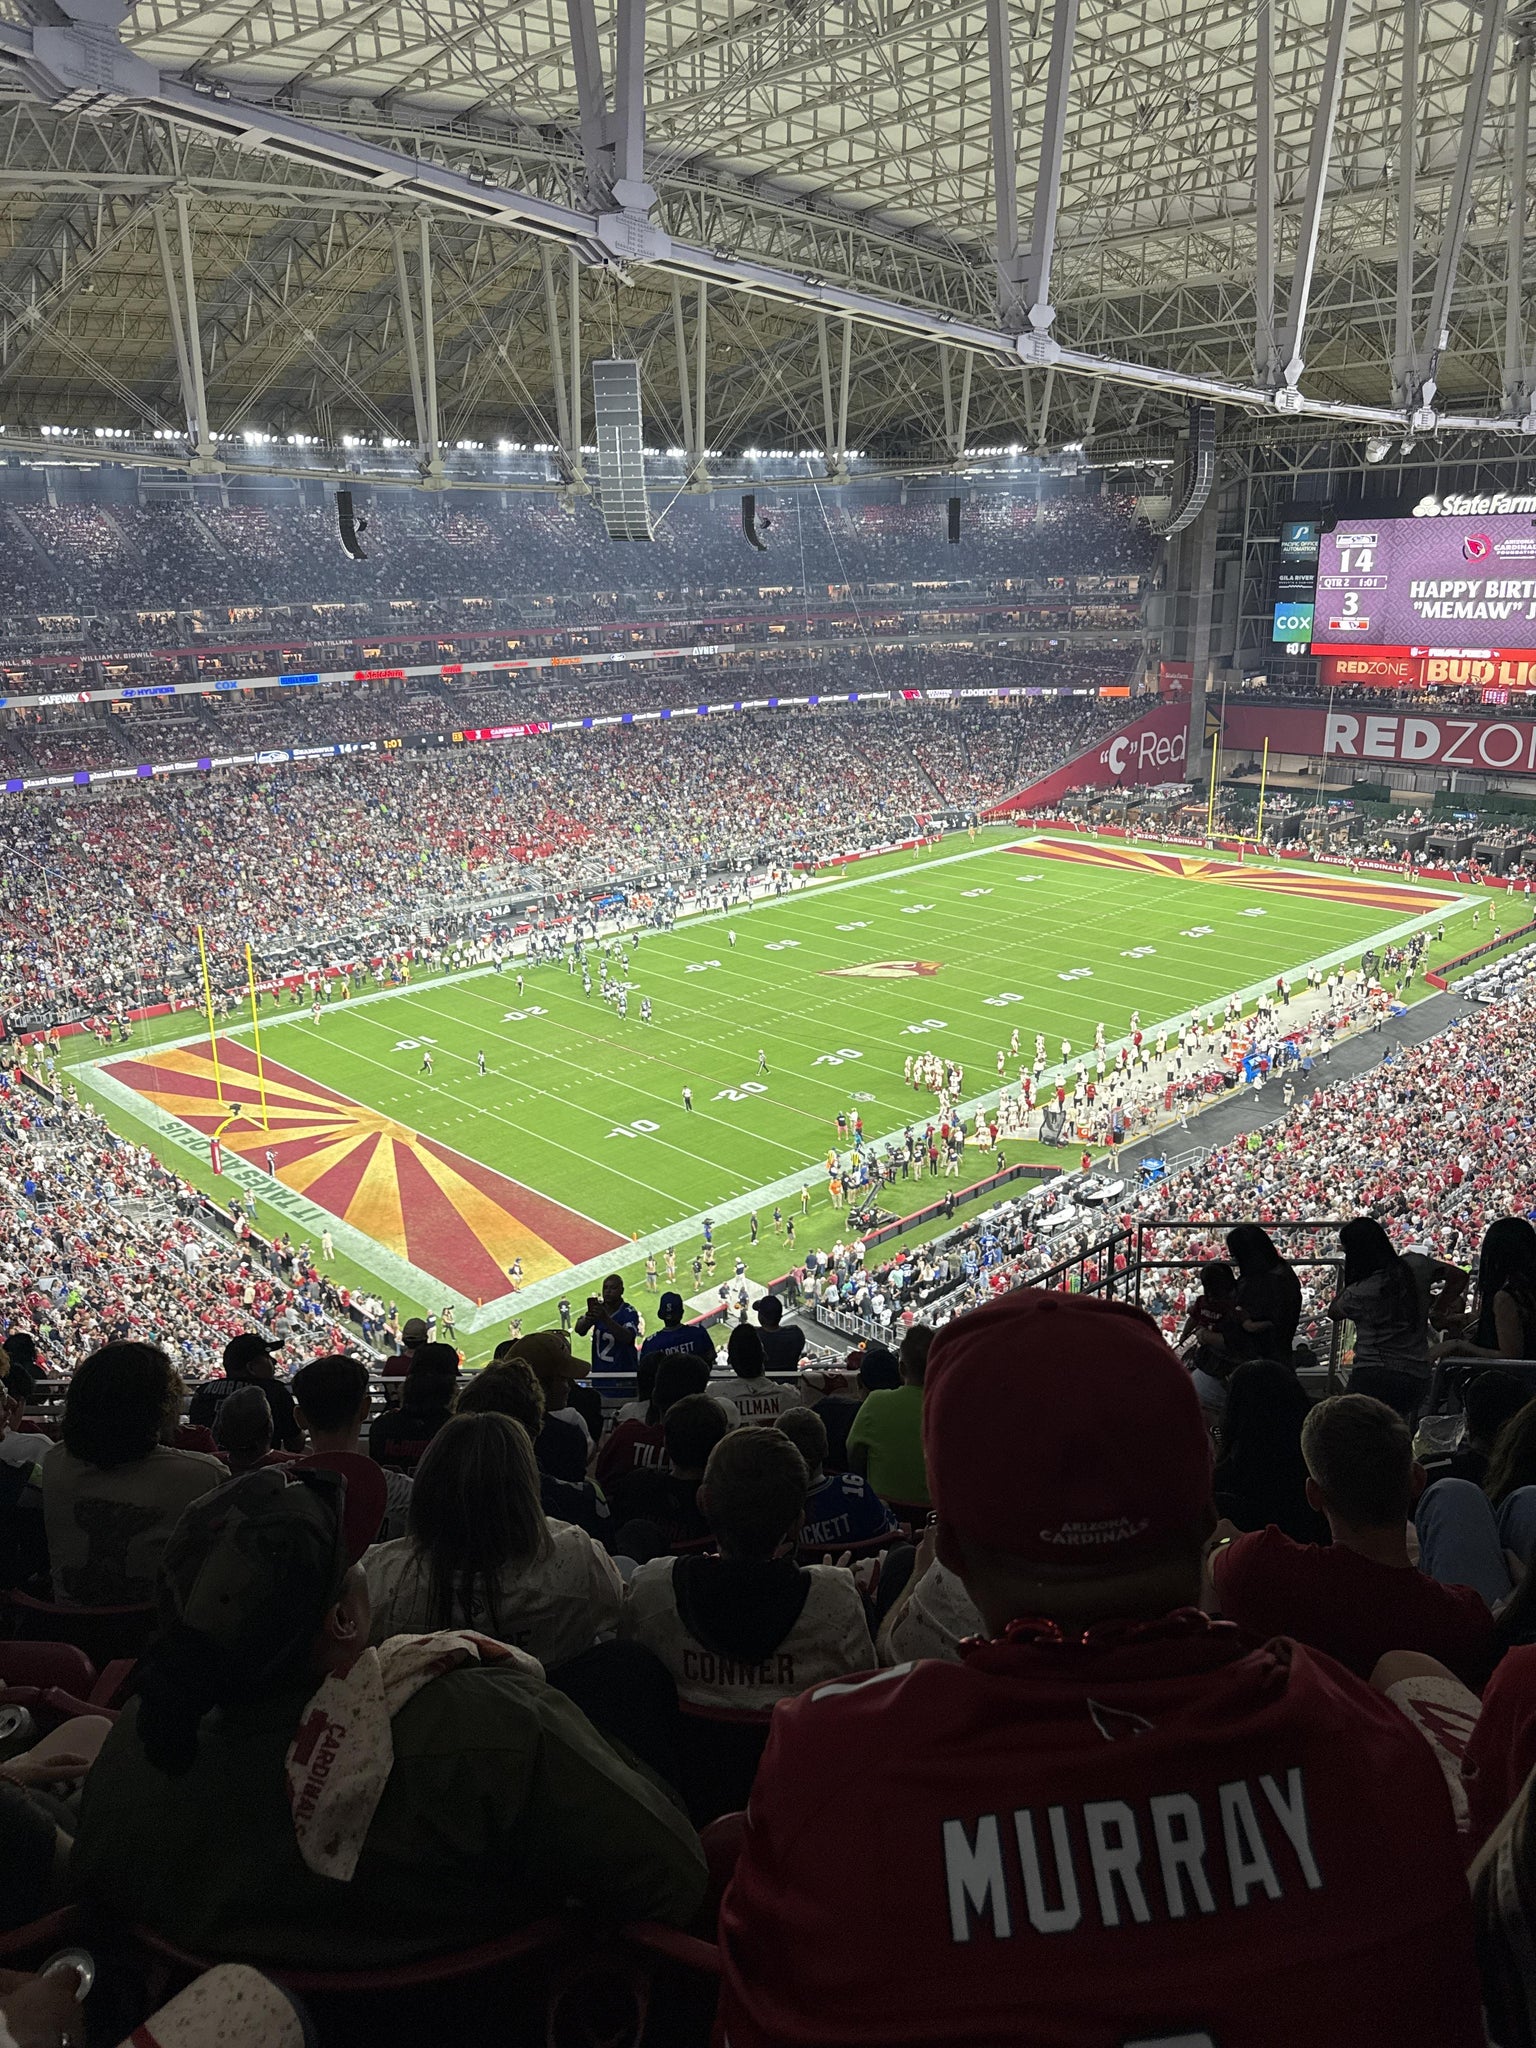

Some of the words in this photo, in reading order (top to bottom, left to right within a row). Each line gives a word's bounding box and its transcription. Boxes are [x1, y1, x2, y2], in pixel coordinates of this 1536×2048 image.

[1340, 548, 1374, 572] 14
[1324, 578, 1343, 586] QTR
[1359, 578, 1378, 586] 1:01
[1410, 580, 1482, 598] HAPPY
[1342, 592, 1358, 616] 3
[1276, 616, 1311, 629] COX
[1336, 661, 1408, 676] REDZONE
[1427, 659, 1495, 684] BUD
[137, 686, 175, 696] HYUNDAI
[214, 681, 238, 690] COX
[38, 694, 78, 706] SAFEWAY
[490, 726, 524, 735] CARDINALS
[339, 744, 352, 753] 14
[383, 738, 402, 749] 1:01
[1138, 725, 1187, 769] Red
[1324, 713, 1536, 769] REDZO
[90, 771, 112, 781] planet
[152, 764, 174, 774] planet
[24, 778, 47, 788] planet
[1358, 860, 1404, 872] CARDINALS
[960, 888, 991, 898] 20
[1236, 908, 1268, 918] 10
[1179, 925, 1215, 938] 20
[764, 938, 802, 951] 50
[1120, 946, 1157, 958] 30
[1057, 967, 1094, 982] 40
[982, 992, 1025, 1007] 50
[507, 1006, 549, 1020] 20
[905, 1018, 948, 1034] 40
[396, 1035, 438, 1050] 10
[815, 1048, 864, 1066] 30
[716, 1082, 768, 1102] 20
[158, 1122, 188, 1138] US
[610, 1119, 661, 1138] 10
[178, 1137, 211, 1152] OF
[234, 1170, 296, 1209] TAKES
[290, 1206, 325, 1223] IT
[596, 1332, 616, 1362] 12
[660, 1341, 695, 1356] OCKETT
[203, 1380, 253, 1395] MURR
[842, 1474, 865, 1498] 16
[1040, 1518, 1150, 1544] CARDINALS
[1061, 1516, 1130, 1532] ARIZONA
[683, 1649, 794, 1686] CONNER
[942, 1766, 1324, 1943] MURRAY
